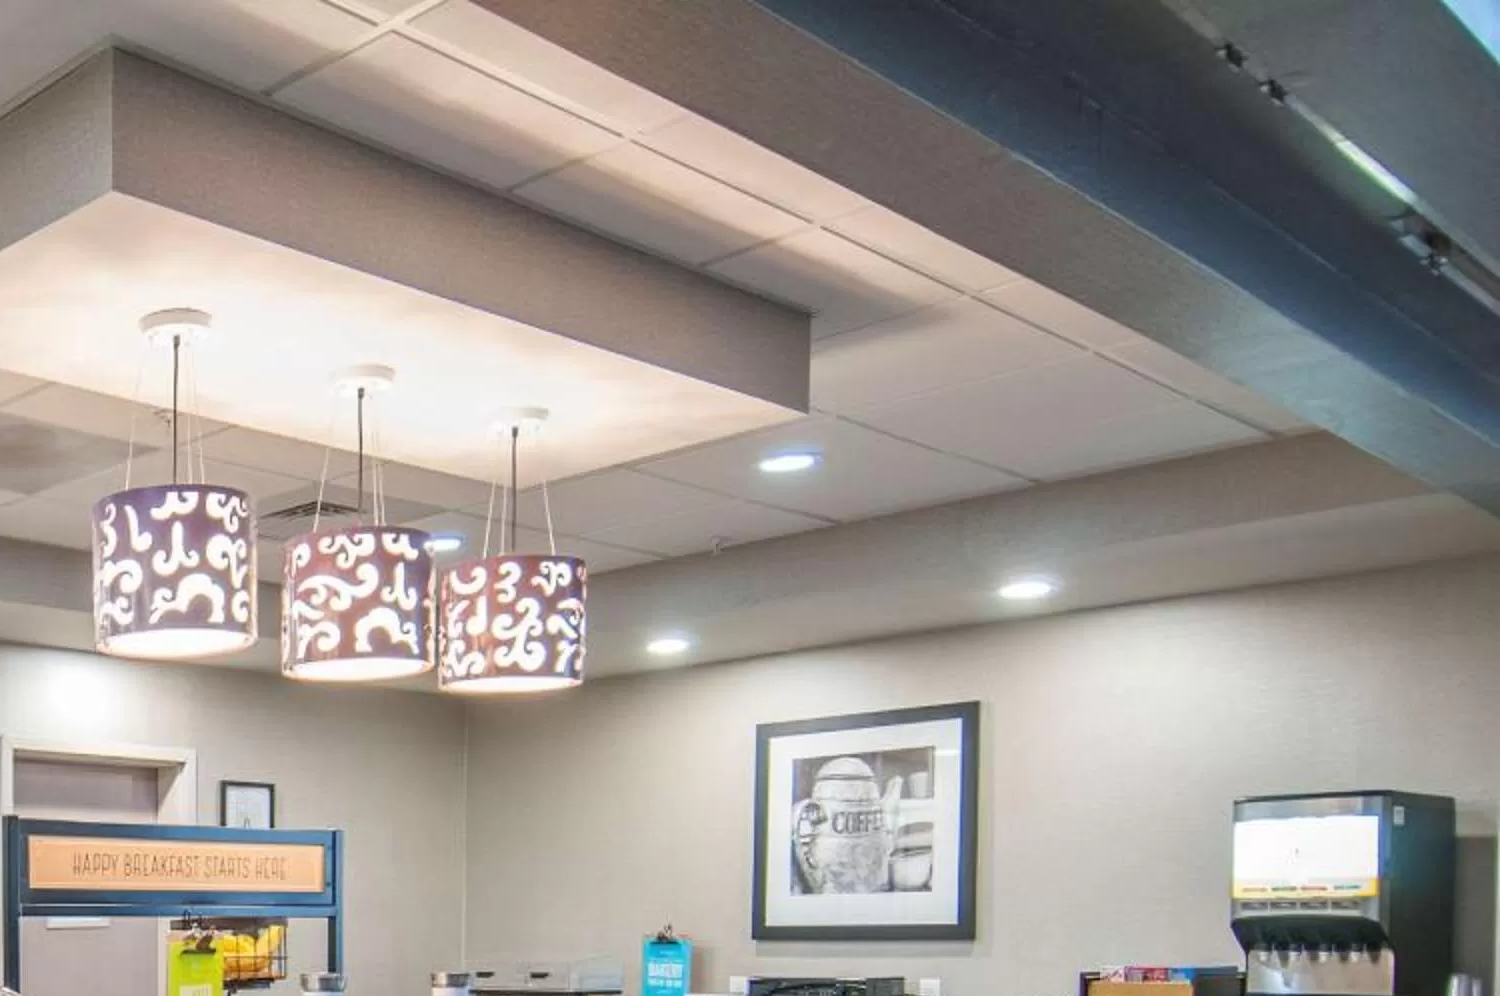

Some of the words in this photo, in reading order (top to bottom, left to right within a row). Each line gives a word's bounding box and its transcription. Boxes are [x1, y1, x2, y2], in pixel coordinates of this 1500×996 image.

[72, 852, 120, 877] HAPPY
[123, 853, 200, 878] BREAKFAST
[203, 855, 251, 879] STARTS
